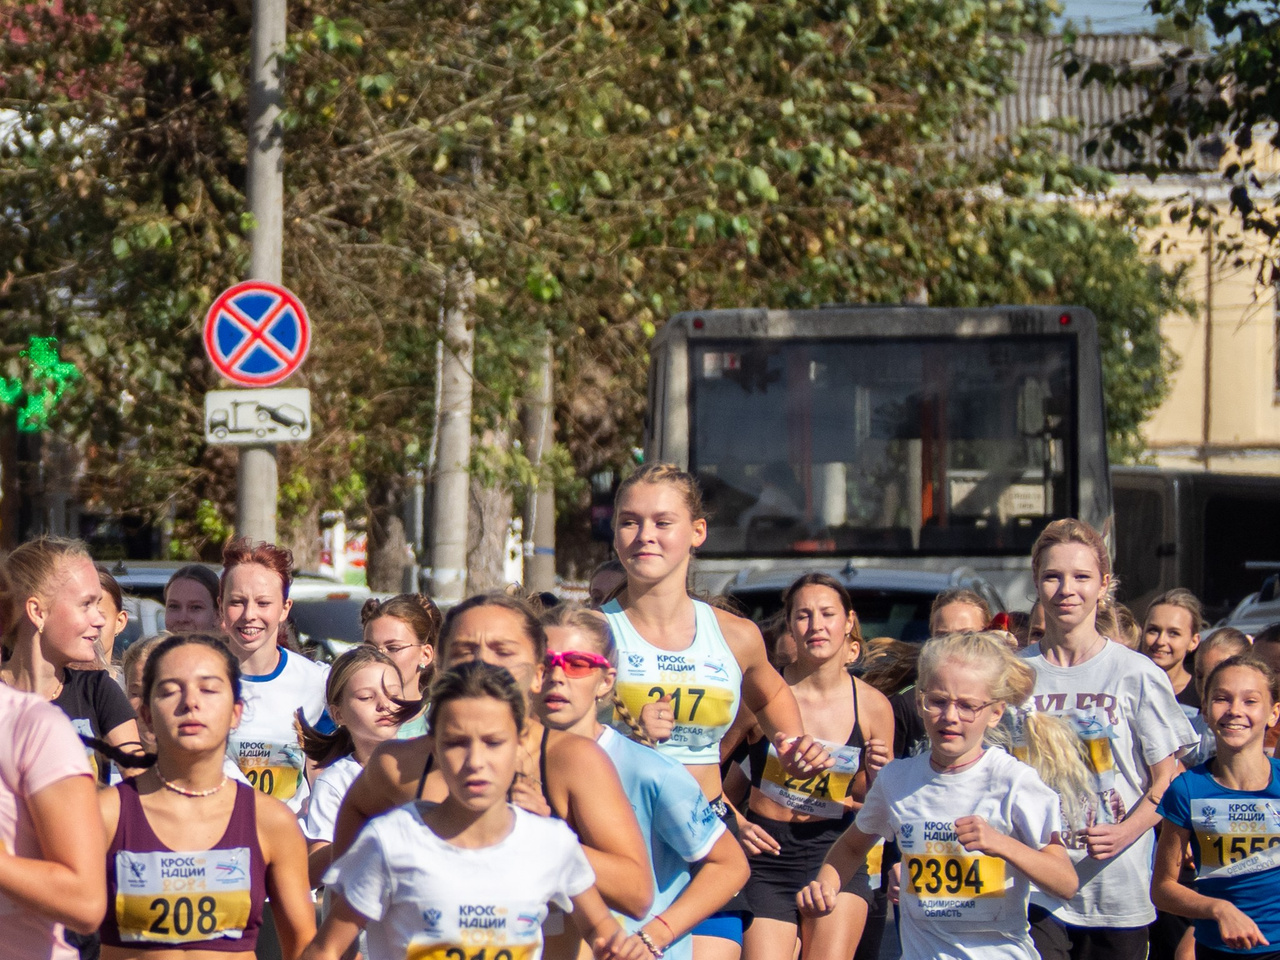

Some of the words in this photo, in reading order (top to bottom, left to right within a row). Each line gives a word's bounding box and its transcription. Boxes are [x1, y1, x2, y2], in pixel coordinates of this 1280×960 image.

[657, 655, 685, 664] КРОСС
[657, 663, 696, 672] НАЦИИ
[240, 741, 265, 750] КРОСС
[239, 749, 271, 758] НАЦИИ
[1229, 804, 1256, 812] КРОСС
[1229, 813, 1265, 821] НАЦИИ
[924, 822, 952, 831] КРОСС
[1230, 822, 1266, 832] 2024
[160, 857, 195, 867] КРОСС
[161, 867, 206, 878] НАЦИИ
[908, 858, 984, 894] 2394
[459, 905, 496, 916] КРОСС
[925, 909, 962, 918] ОБЛАСТЬ
[149, 896, 217, 935] 208
[459, 917, 507, 929] НАЦИИ
